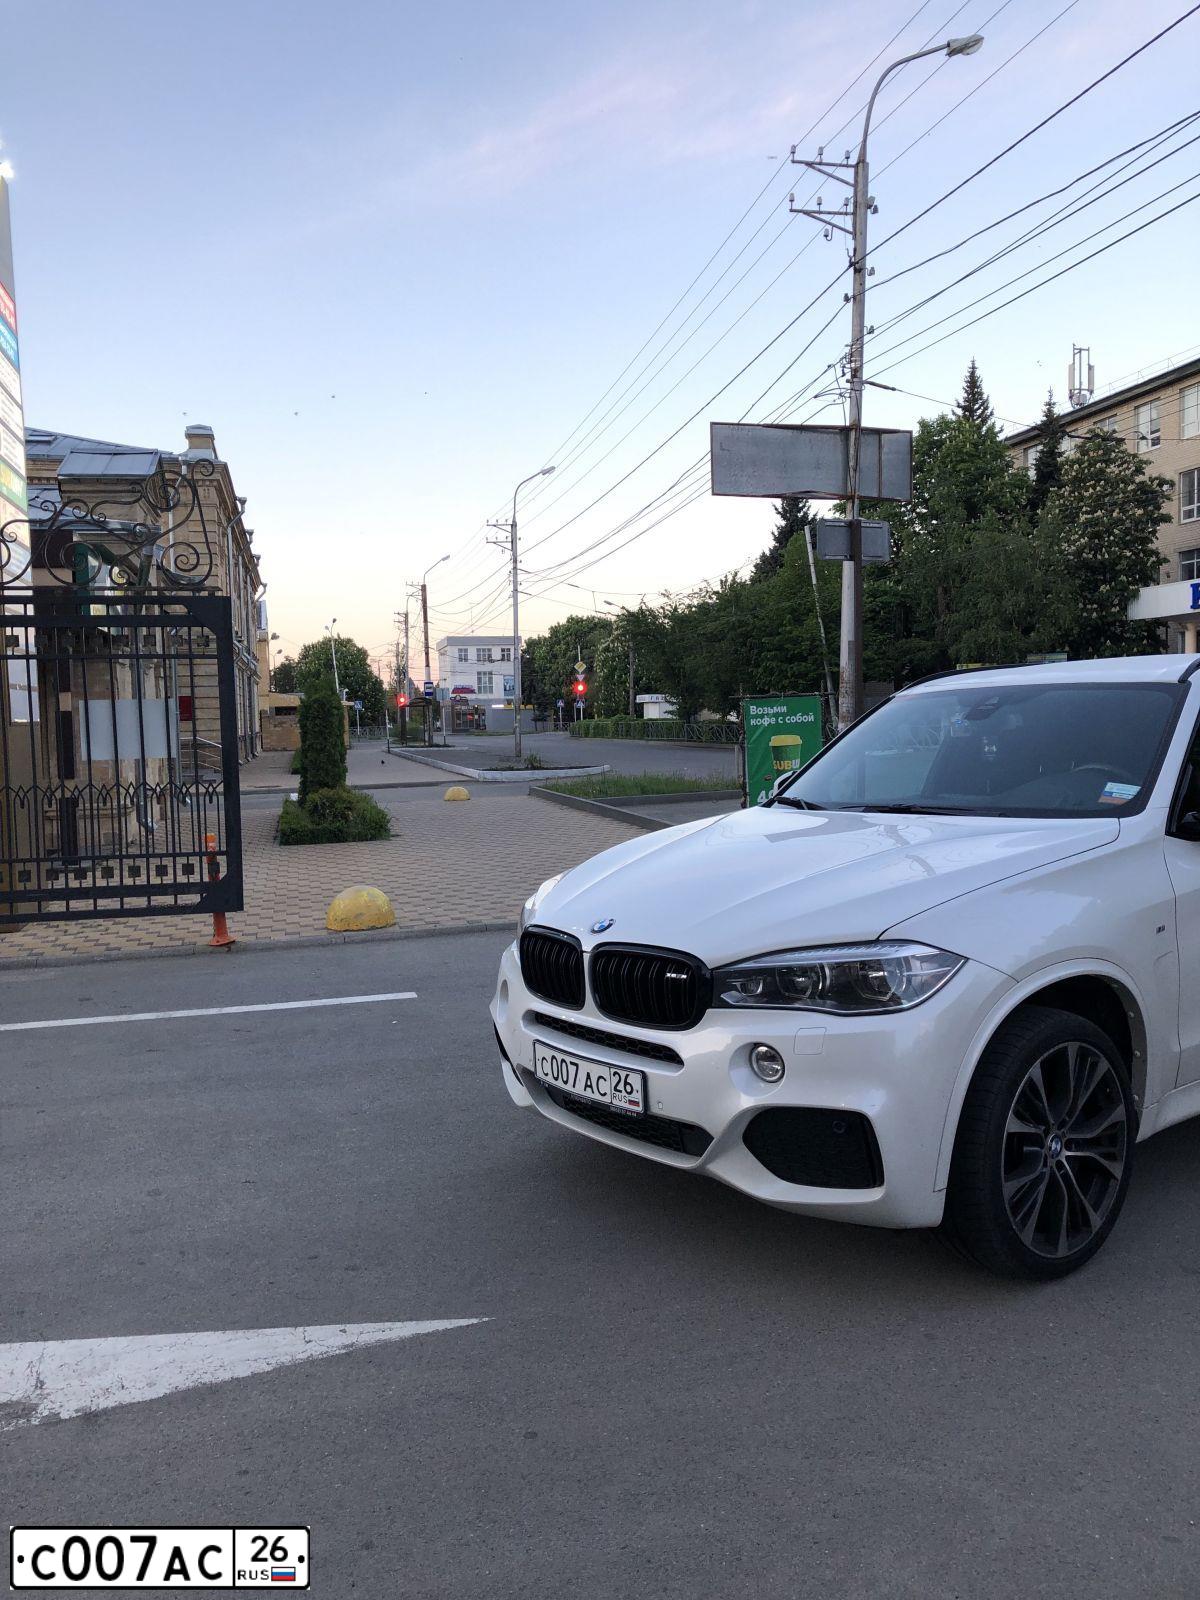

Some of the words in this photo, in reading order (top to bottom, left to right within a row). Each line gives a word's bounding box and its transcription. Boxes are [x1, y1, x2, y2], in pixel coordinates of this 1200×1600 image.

[750, 705, 787, 715] Возьми
[750, 716, 776, 726] кофе
[785, 713, 815, 723] собой
[612, 1070, 634, 1096] 26
[612, 1092, 628, 1104] RUS
